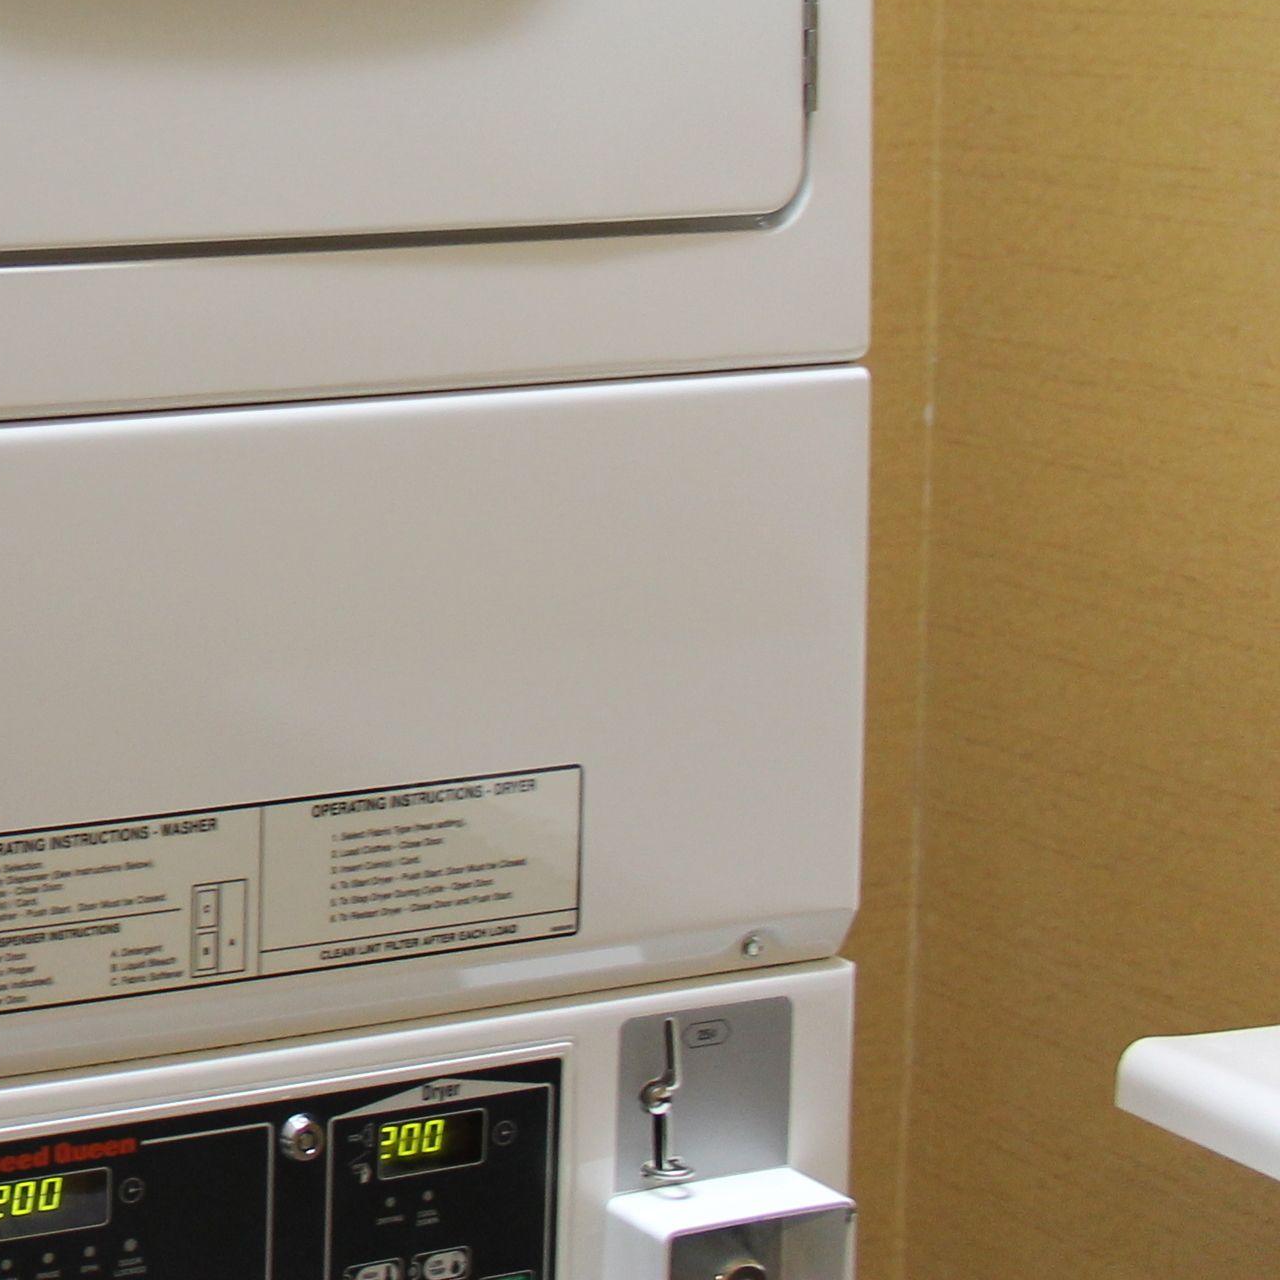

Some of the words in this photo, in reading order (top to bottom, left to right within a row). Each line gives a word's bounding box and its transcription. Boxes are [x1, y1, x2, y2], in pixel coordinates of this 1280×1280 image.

[311, 797, 387, 818] OPERATING
[391, 785, 483, 807] INSTRUCTIONS
[494, 778, 536, 795] DRYER
[50, 826, 150, 850] INSTRUCTIONS
[161, 818, 218, 837] WASHER
[321, 946, 355, 960] CLEAN
[358, 942, 381, 955] LINT
[384, 938, 418, 951] FILTER
[423, 932, 455, 945] AFTER
[459, 928, 487, 941] EACH
[490, 924, 518, 937] LOAD
[422, 1083, 460, 1101] Dryer
[54, 1137, 138, 1165] Queen
